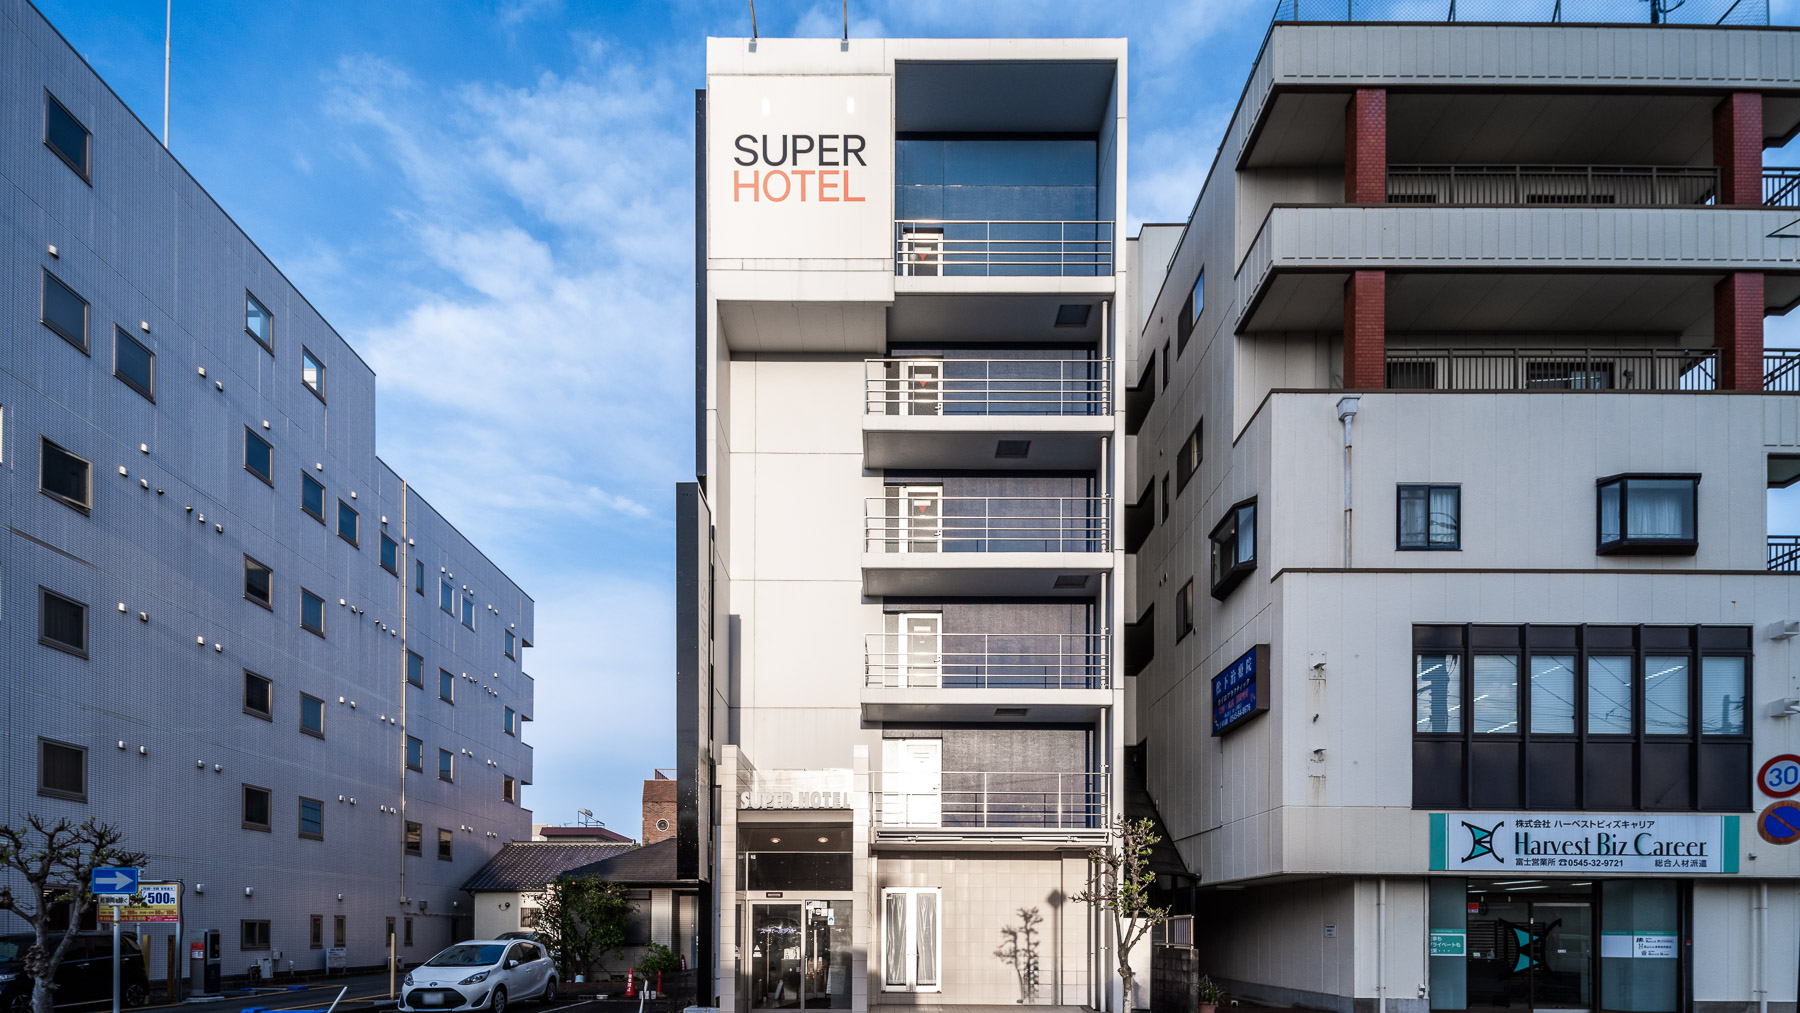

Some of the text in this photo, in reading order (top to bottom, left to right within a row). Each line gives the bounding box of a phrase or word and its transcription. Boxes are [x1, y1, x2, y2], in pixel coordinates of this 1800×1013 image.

[734, 134, 867, 167] SUPER
[733, 170, 866, 203] HOTEL
[1769, 765, 1799, 787] 30
[740, 791, 851, 809] SUPER HOTEL
[1515, 819, 1655, 829] 株式会社 ハーベストビィズキャリア
[1515, 831, 1707, 856] Harvest Biz Career
[1515, 857, 1624, 867] 富士営業所 0545-32-9721
[1654, 858, 1707, 868] 総合人材派遣
